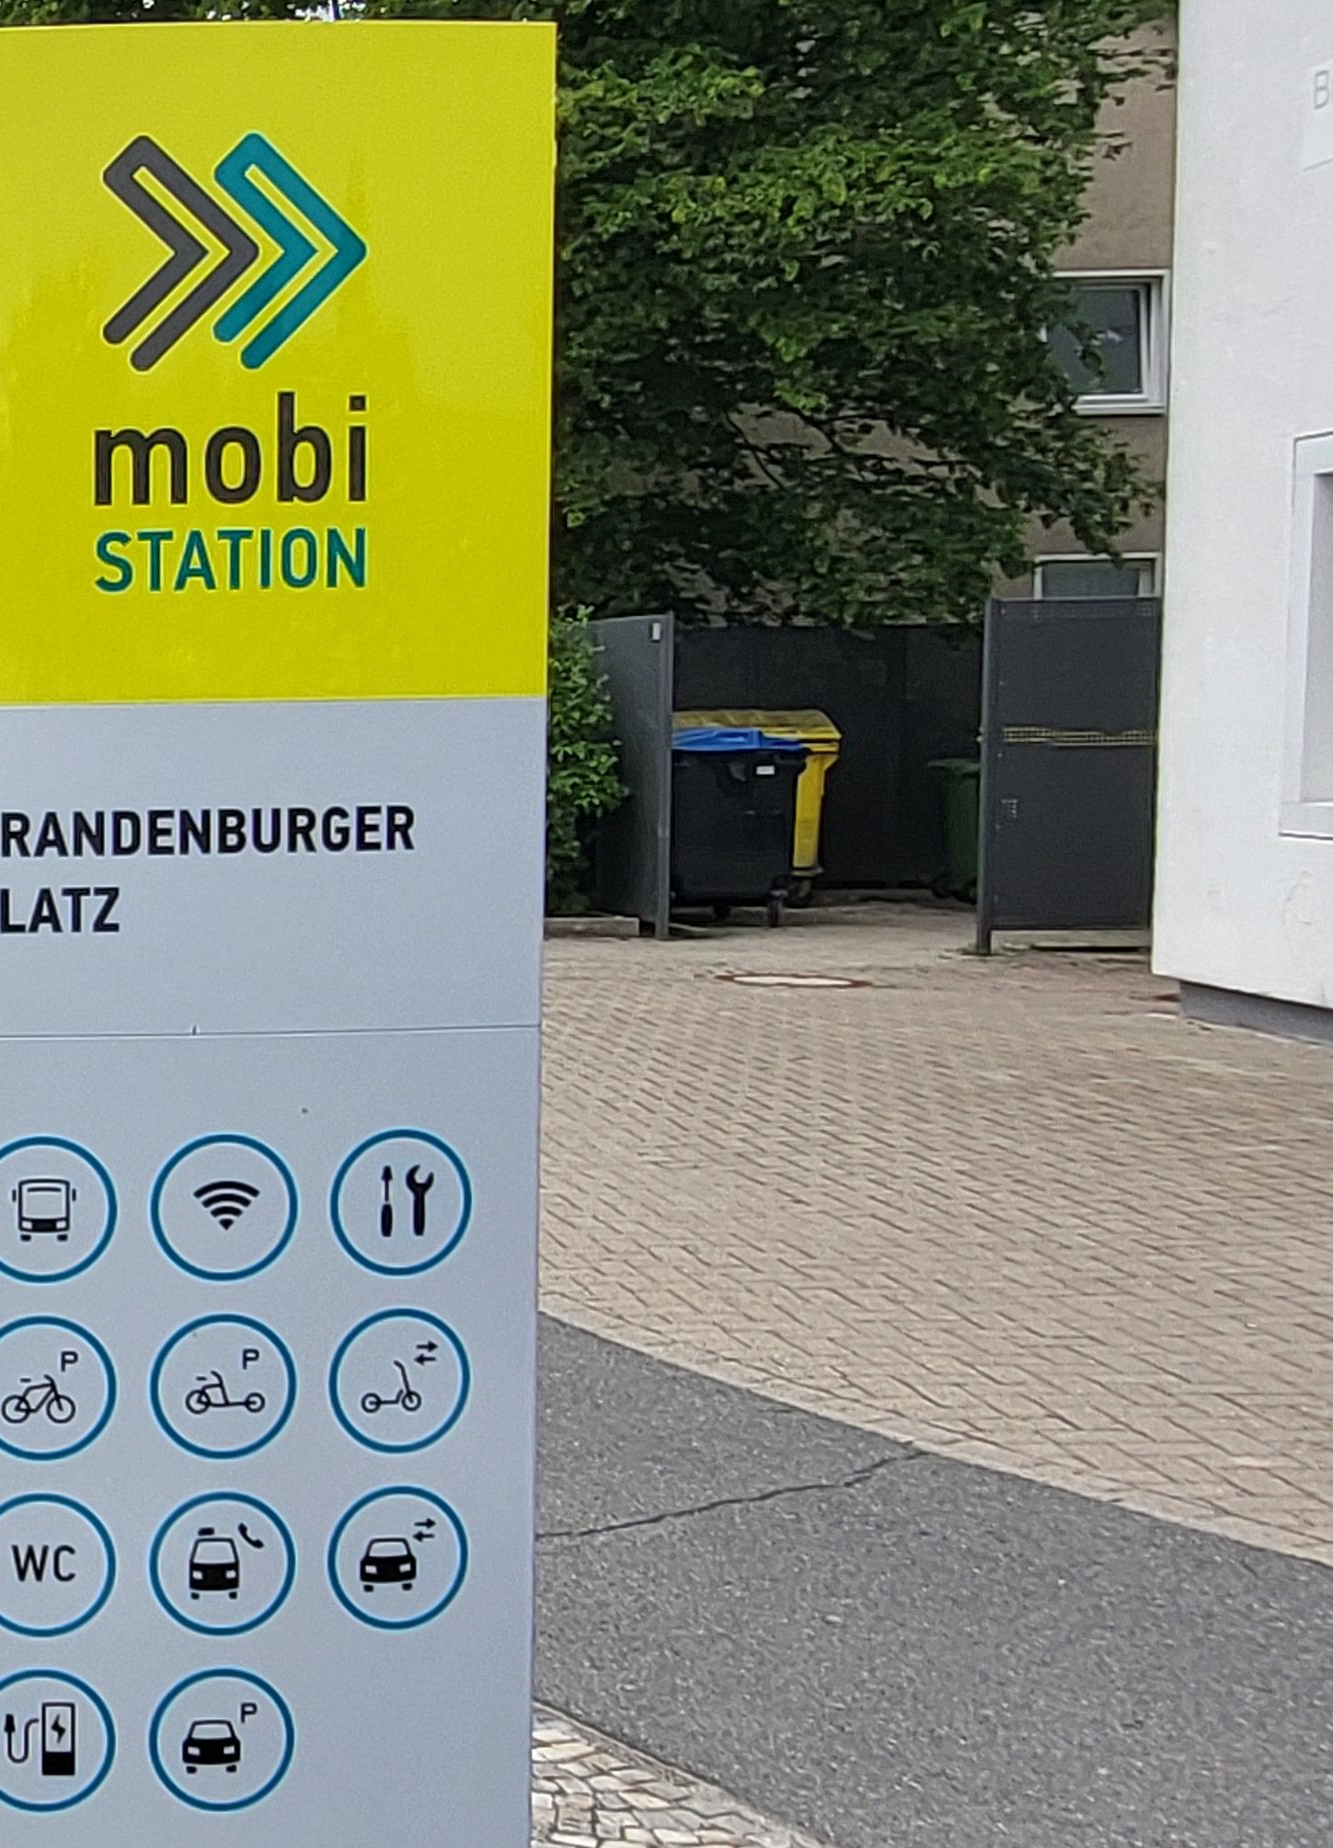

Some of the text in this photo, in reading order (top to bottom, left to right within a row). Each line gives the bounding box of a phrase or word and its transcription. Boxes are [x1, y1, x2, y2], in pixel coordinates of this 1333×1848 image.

[94, 391, 367, 506] mobi
[95, 527, 367, 592] STATION
[60, 1350, 79, 1372] P
[242, 1348, 260, 1370] P
[11, 1544, 76, 1582] WC
[240, 1702, 258, 1724] P
